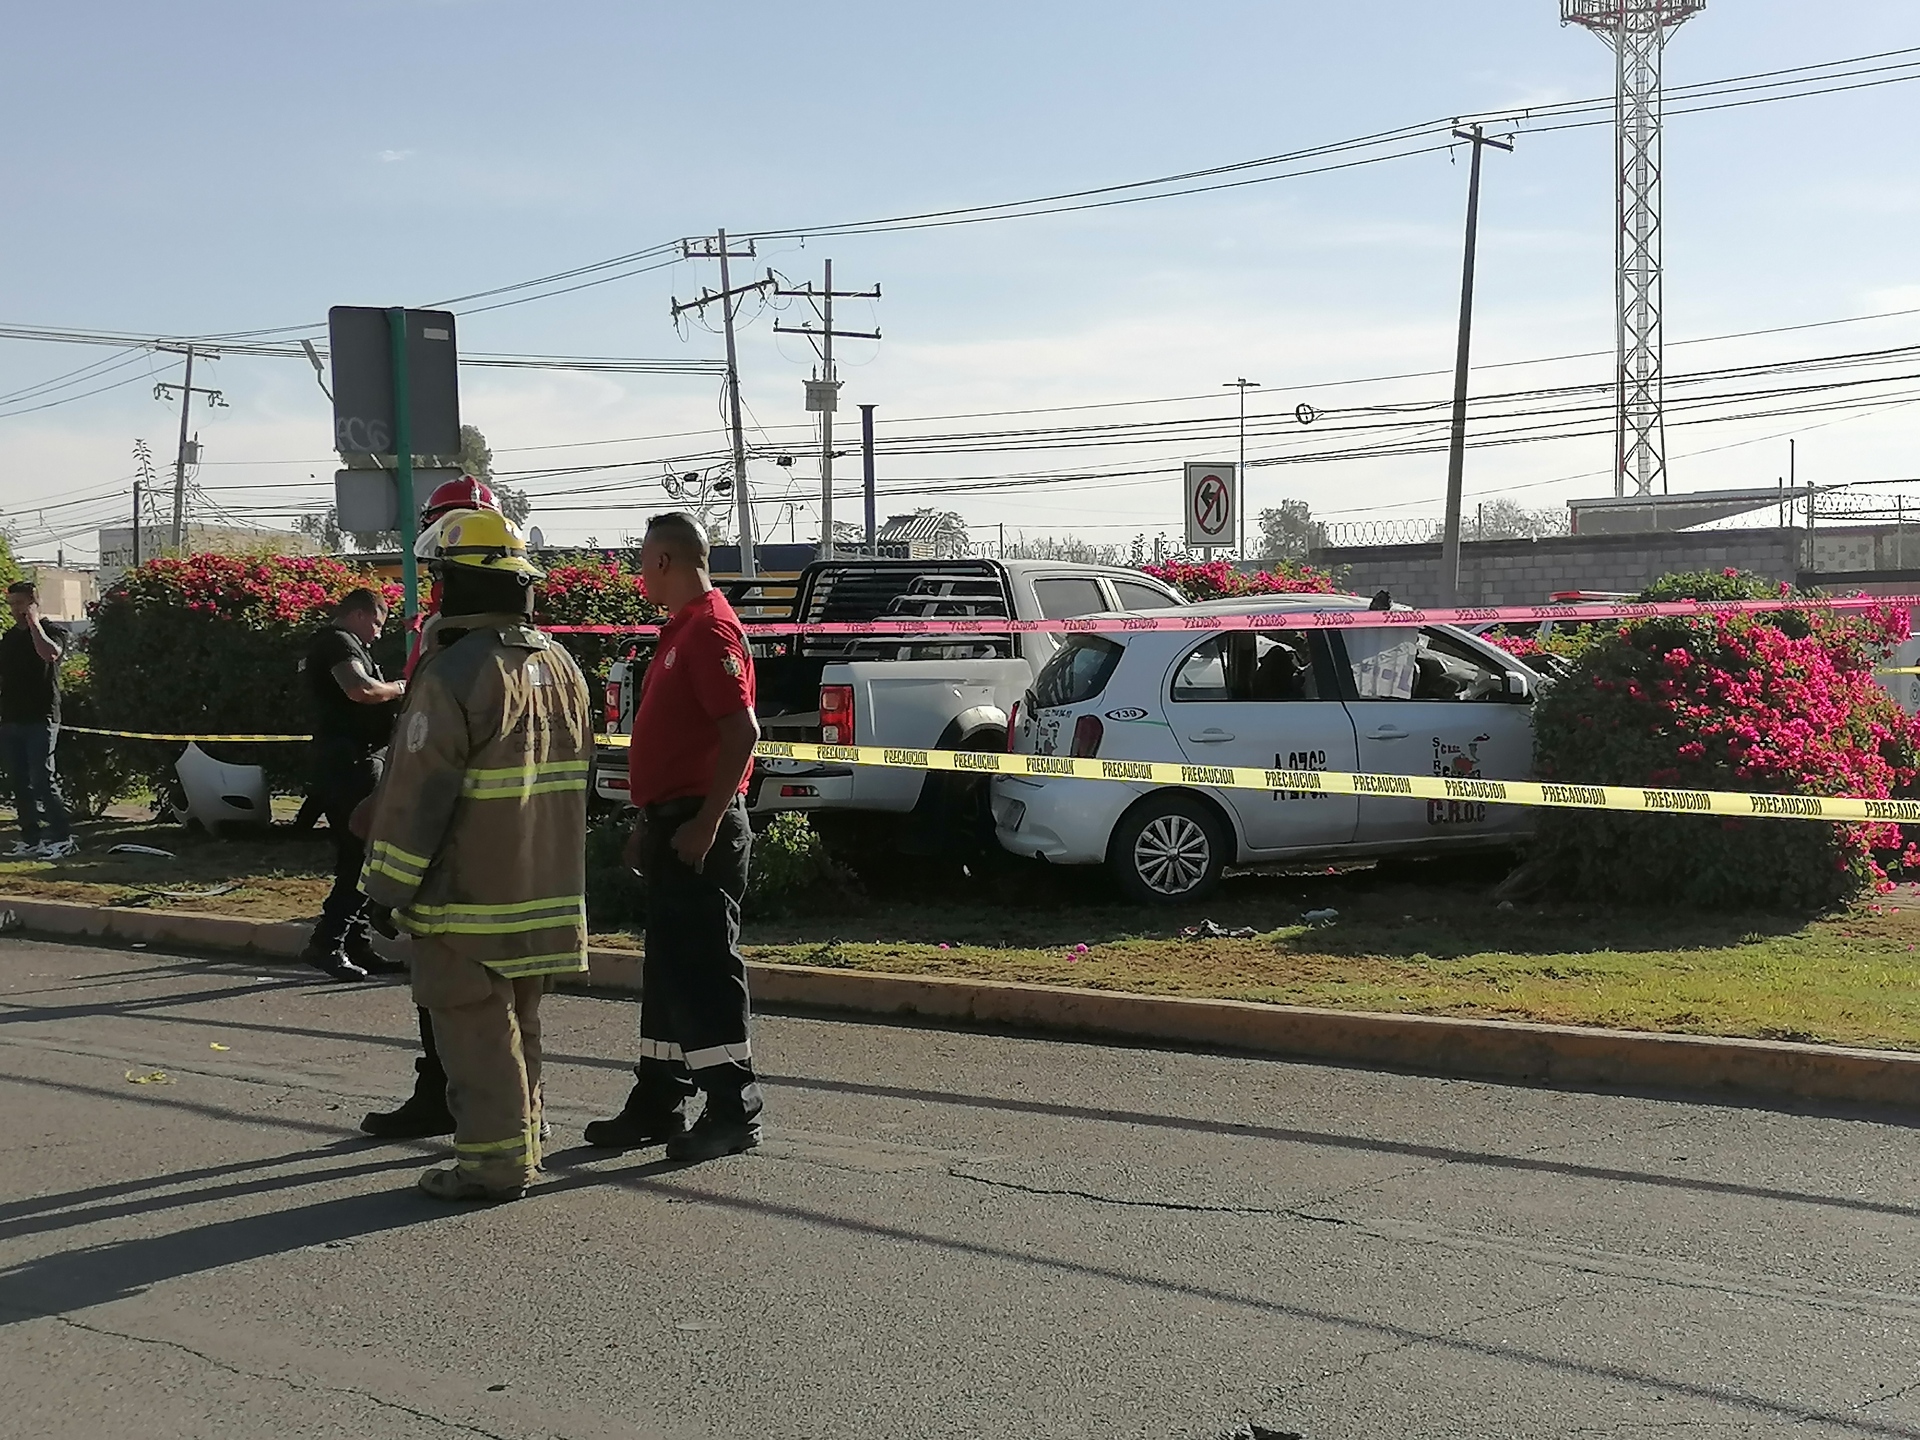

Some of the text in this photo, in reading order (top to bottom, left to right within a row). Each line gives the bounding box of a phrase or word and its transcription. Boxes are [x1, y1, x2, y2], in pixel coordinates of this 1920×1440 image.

[1114, 708, 1138, 719] 139
[1026, 757, 1076, 775] PRECAUCION
[1101, 761, 1154, 780] PRECAUCION
[1181, 765, 1236, 785] PRECAUCION
[1264, 770, 1322, 790] PRECAUCION
[1352, 775, 1413, 794] PRECAUCION
[1443, 779, 1508, 800] PRECAUCION
[1540, 784, 1607, 806] PRECAUCION
[1642, 789, 1712, 812] PRECAUCION
[1749, 795, 1823, 816] PRECAUCION
